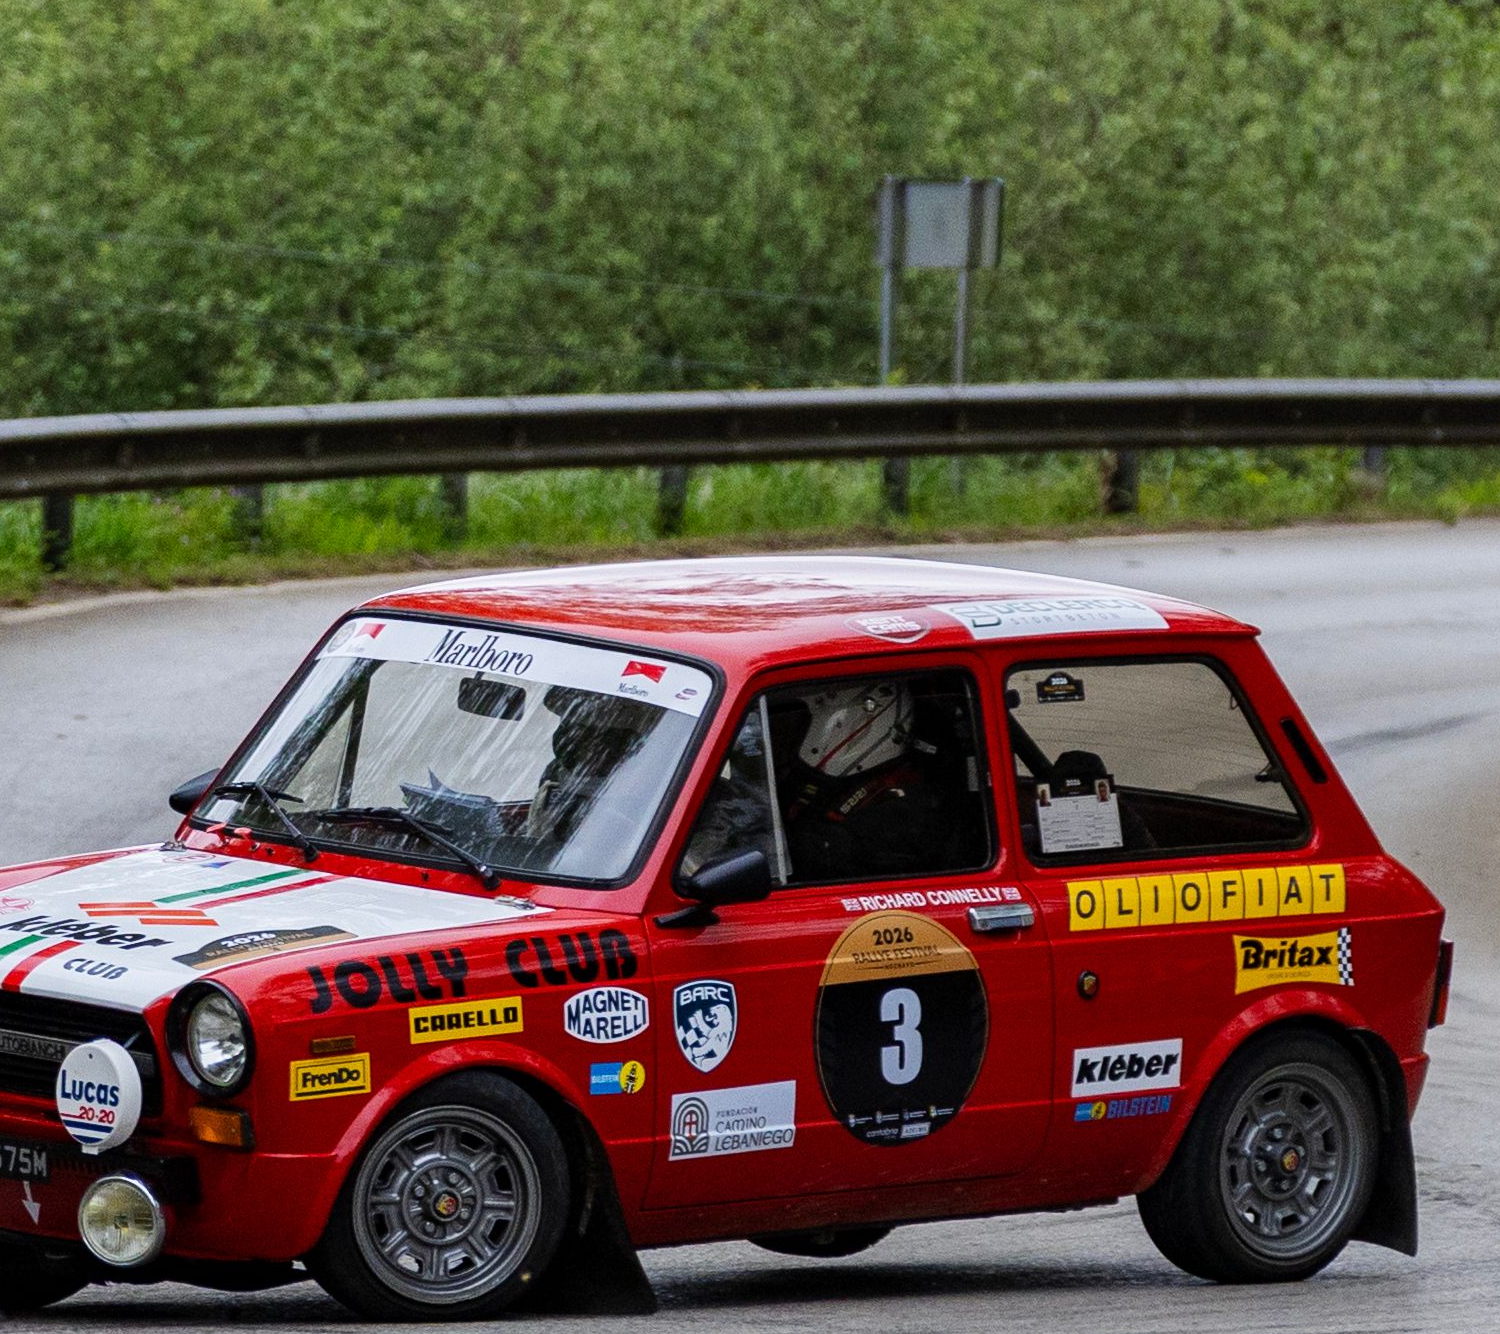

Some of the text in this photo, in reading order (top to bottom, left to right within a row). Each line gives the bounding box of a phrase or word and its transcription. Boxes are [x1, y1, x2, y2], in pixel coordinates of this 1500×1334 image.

[424, 629, 534, 676] Marlboro
[859, 887, 1003, 911] RICHARD CONNELLY
[221, 933, 276, 947] 2026
[873, 927, 914, 946] 2026
[852, 944, 942, 964] RALLYE FESTIVAL
[1240, 939, 1333, 970] Britax
[63, 958, 129, 979] CLUB
[305, 929, 638, 1015] JOLLY CLUB
[680, 986, 730, 1006] BARC
[414, 1006, 518, 1033] CARELLO
[567, 1010, 646, 1039] MARELLI
[880, 987, 923, 1085] 3
[302, 1068, 360, 1088] FrenDo
[1075, 1052, 1179, 1085] kléber
[61, 1069, 120, 1107] Lucas
[1106, 1094, 1172, 1119] BILSTEIN
[715, 1116, 767, 1134] CAMINO
[714, 1128, 794, 1152] LEBANIEGO
